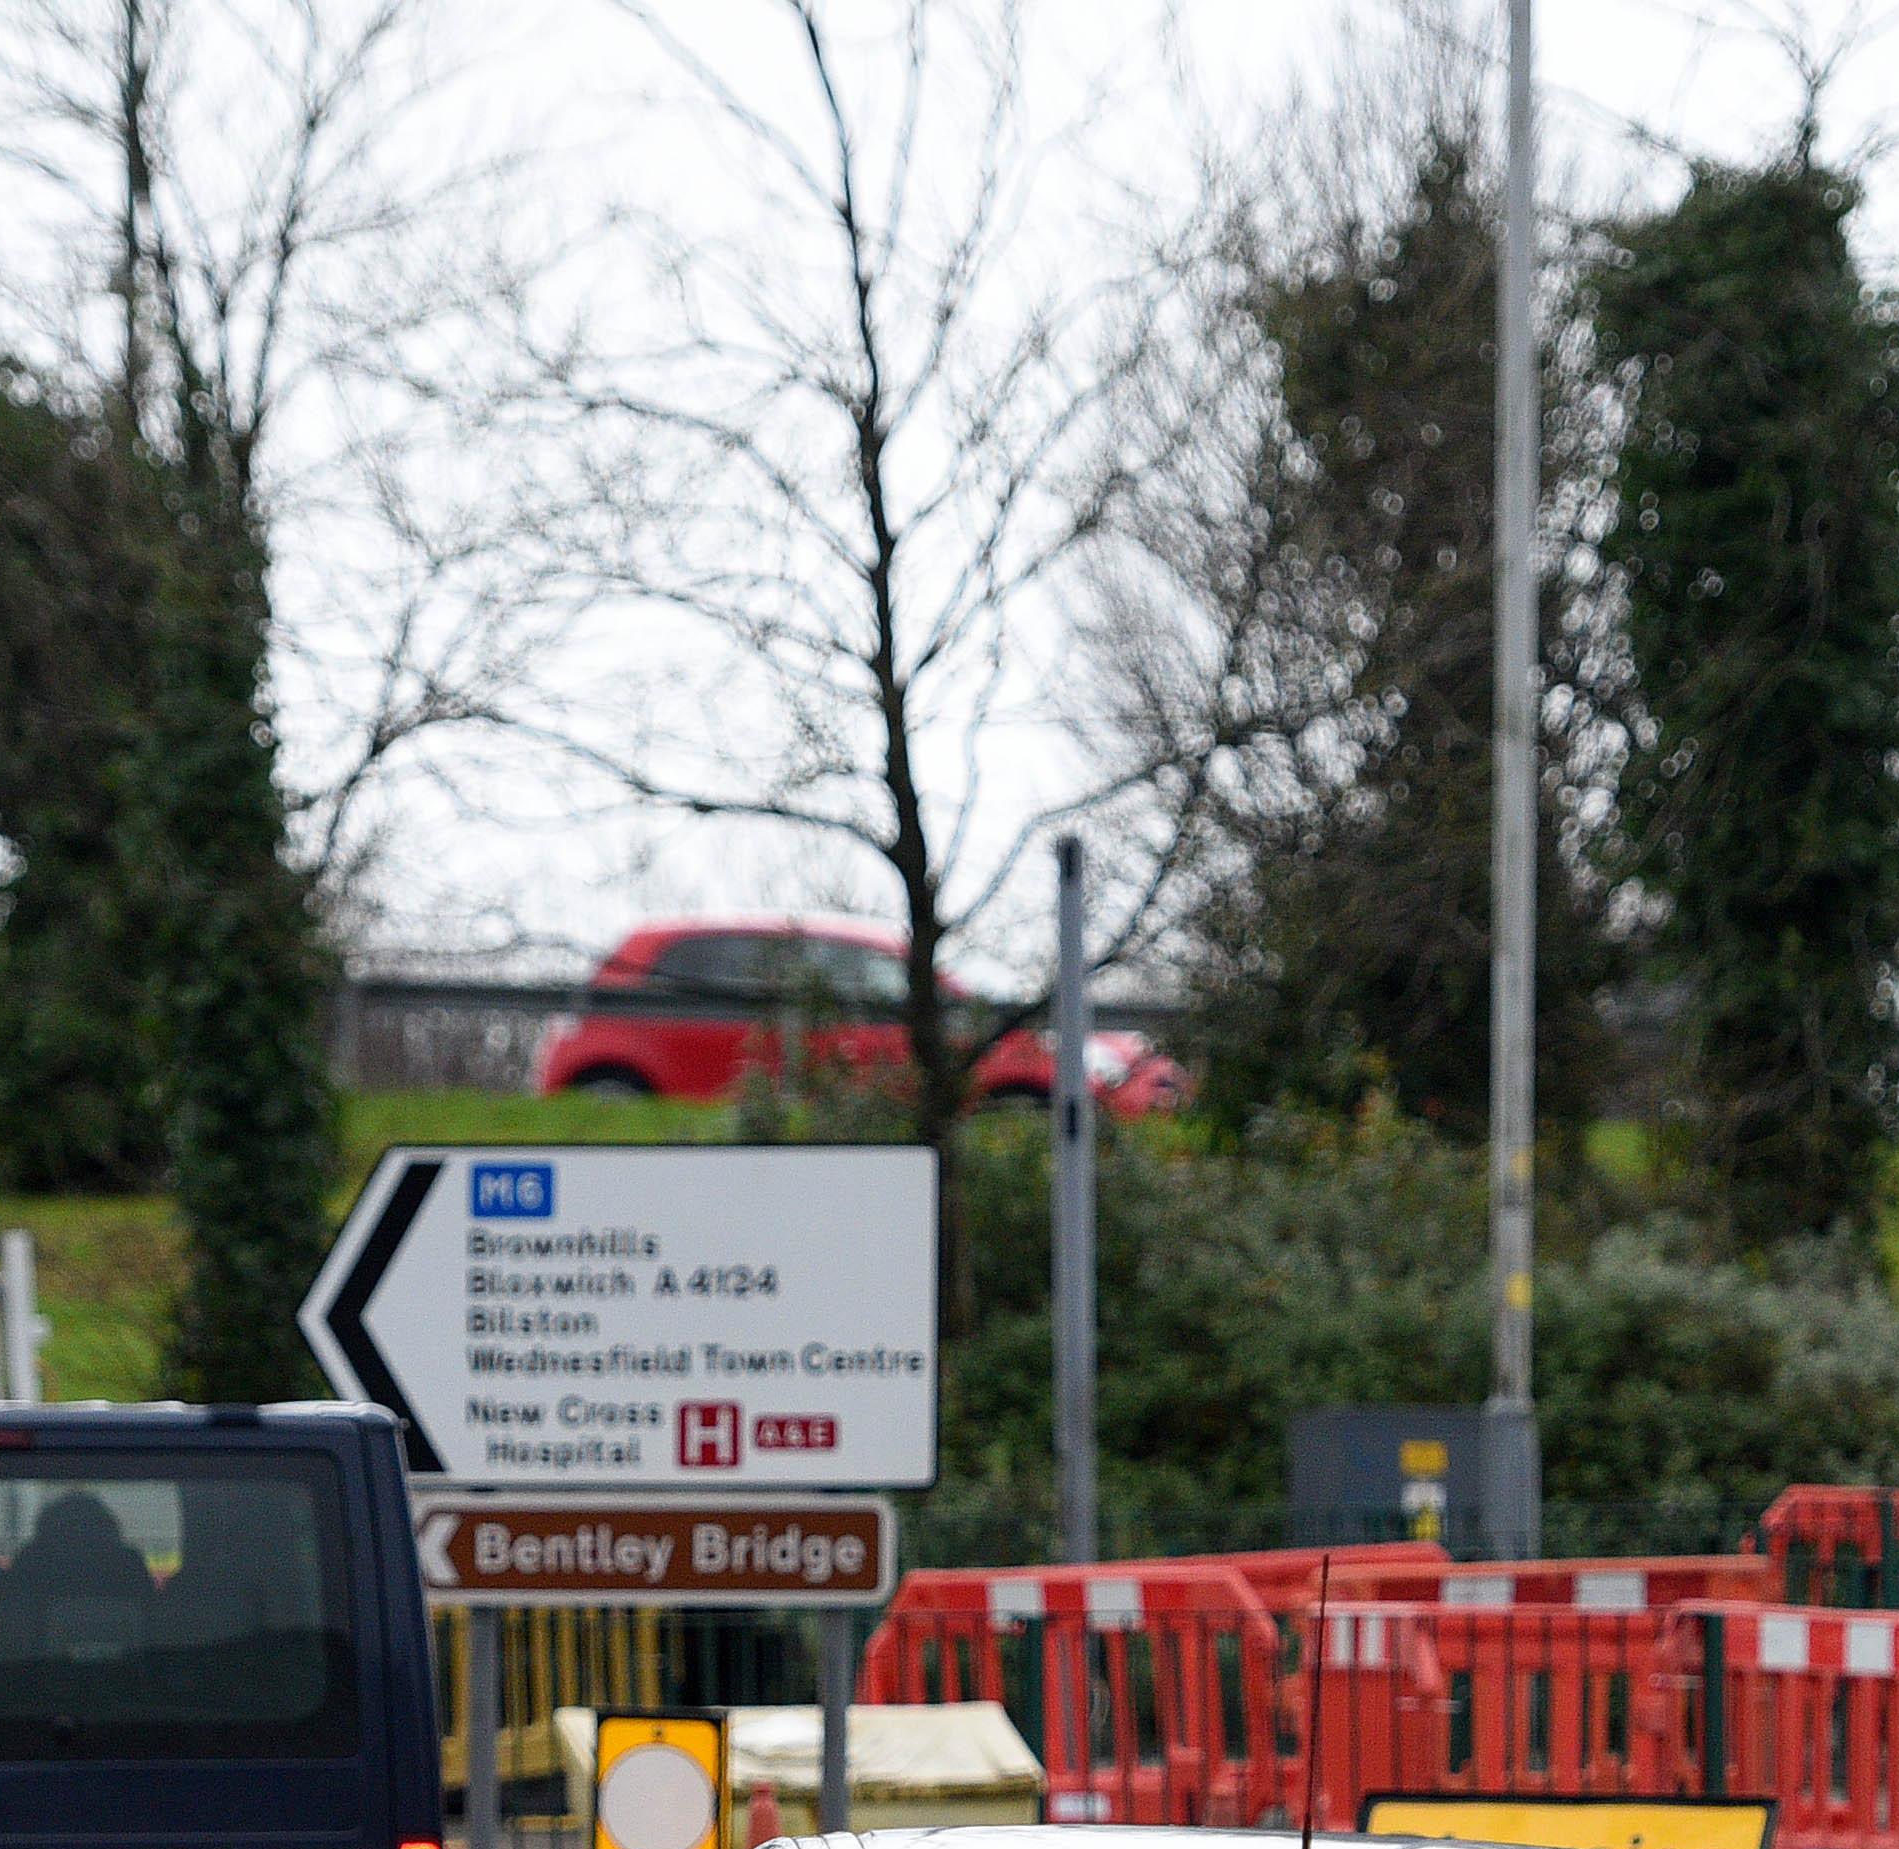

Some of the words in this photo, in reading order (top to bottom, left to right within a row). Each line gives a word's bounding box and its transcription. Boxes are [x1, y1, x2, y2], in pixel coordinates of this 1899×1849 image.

[479, 1172, 544, 1208] M6
[468, 1228, 660, 1258] Brownhills
[468, 1306, 598, 1335] Bilston
[468, 1344, 691, 1374] Wednesfield
[705, 1344, 794, 1374] Town
[802, 1343, 926, 1375] Centre
[468, 1400, 542, 1426] New
[559, 1397, 664, 1427] Cross
[487, 1436, 642, 1469] Hospital
[474, 1522, 675, 1584] Bentley
[692, 1522, 867, 1584] Bridge
